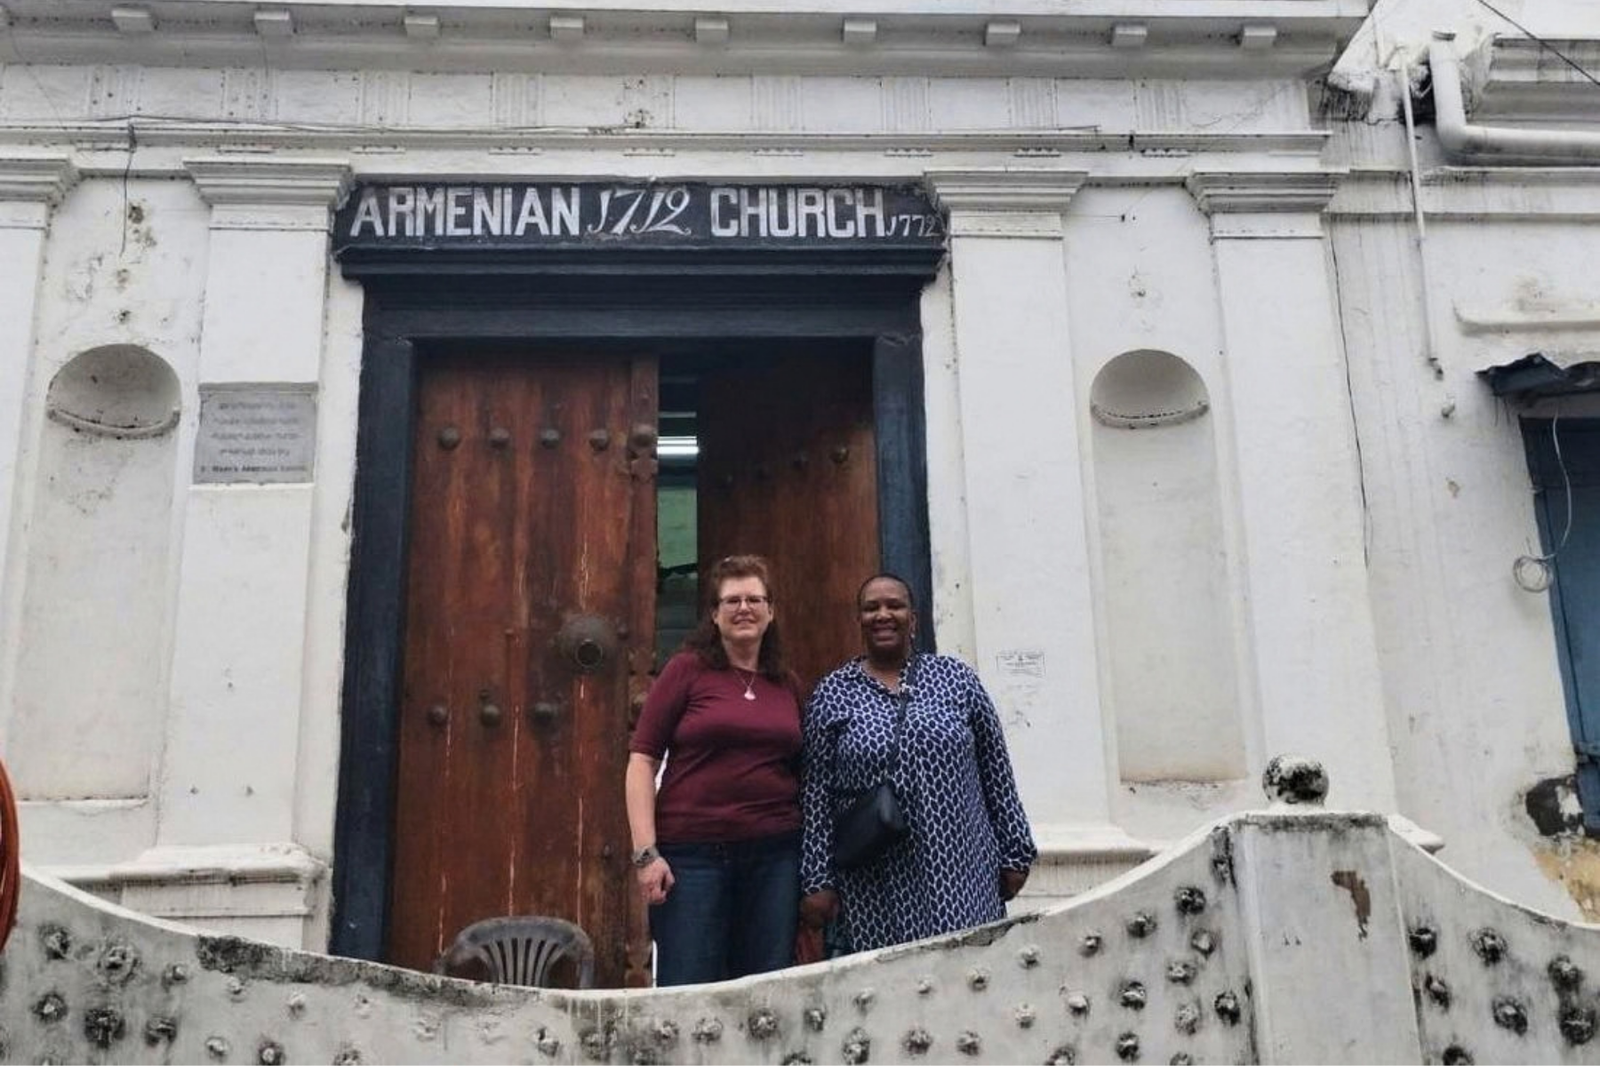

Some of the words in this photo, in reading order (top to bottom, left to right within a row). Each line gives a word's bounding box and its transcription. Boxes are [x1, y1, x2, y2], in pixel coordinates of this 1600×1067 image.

[350, 186, 580, 237] ARMENIAN
[588, 184, 692, 236] 1712
[710, 187, 885, 238] CHURCH
[886, 213, 940, 238] 1772
